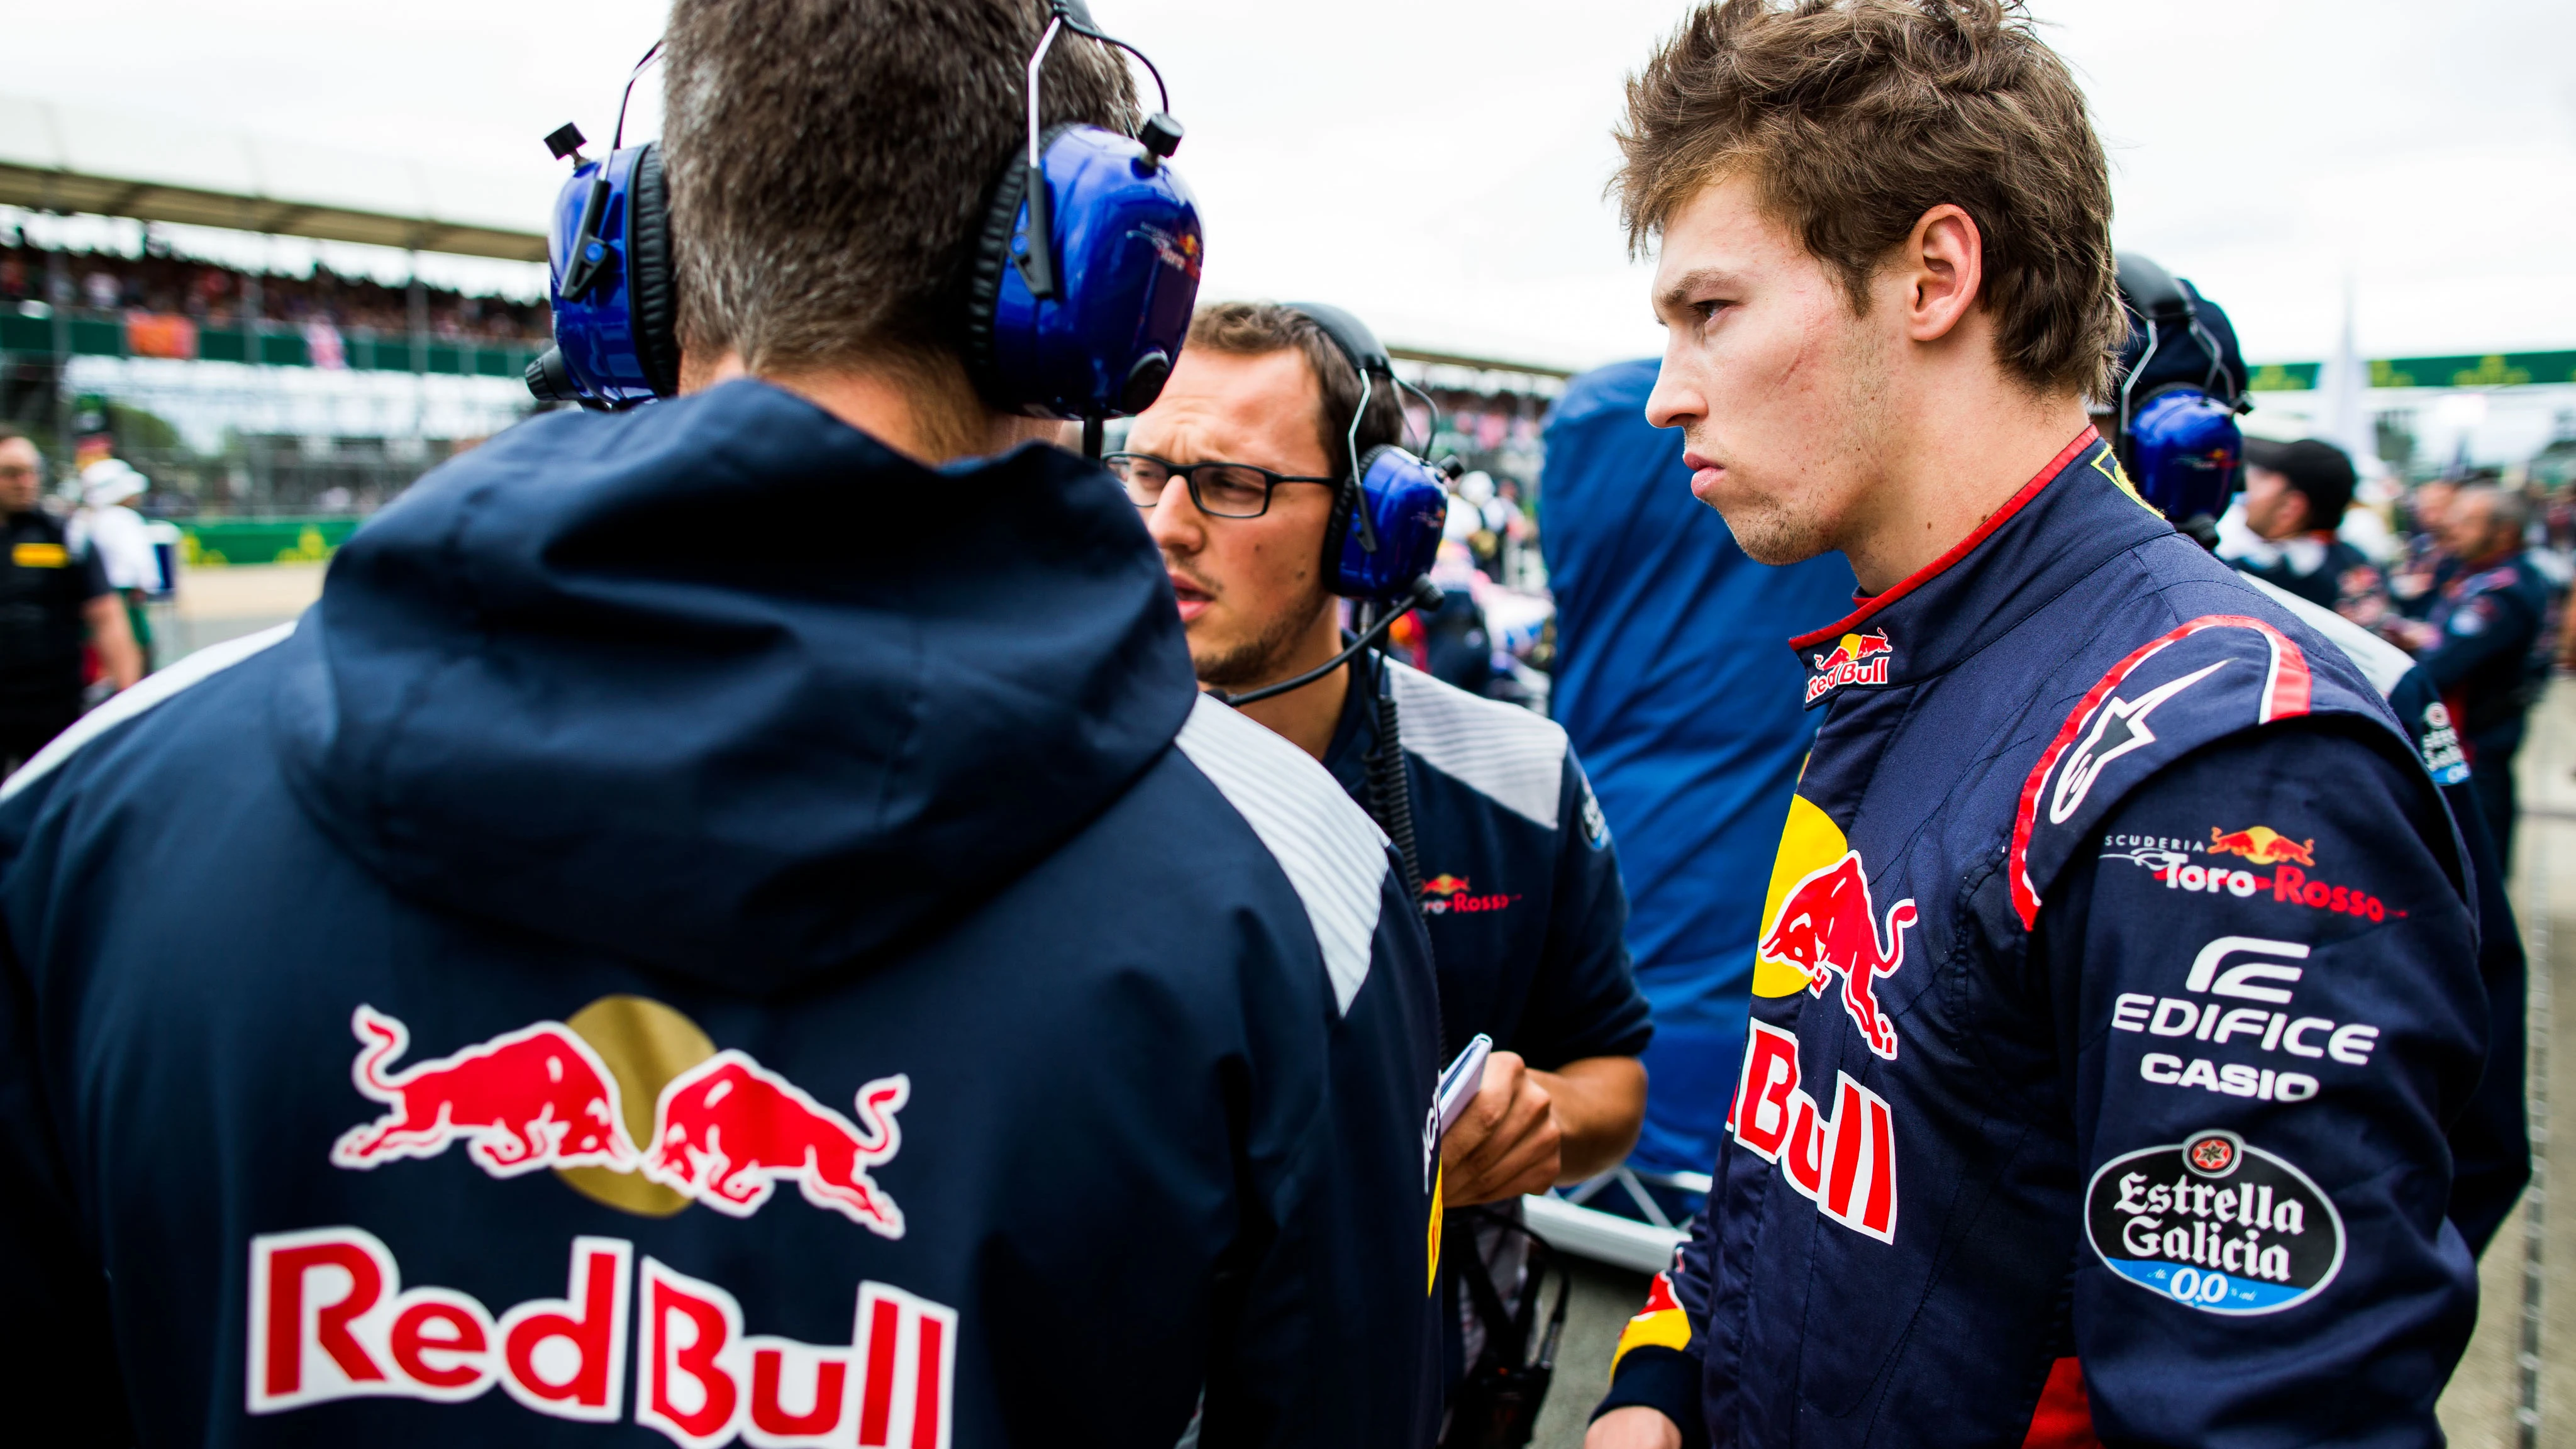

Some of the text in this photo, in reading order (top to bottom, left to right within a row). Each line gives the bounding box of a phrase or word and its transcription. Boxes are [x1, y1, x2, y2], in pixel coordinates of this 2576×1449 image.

[1806, 657, 1890, 703] Red Bull
[2105, 835, 2205, 852] SCUDERIA
[1453, 892, 1509, 913] Rosso
[2160, 852, 2385, 923] Toro Rosso
[2111, 992, 2380, 1065] EDIFICE
[2140, 1052, 2320, 1103] CASIO
[1735, 1018, 1897, 1244] Bull
[2113, 1172, 2305, 1235] Estrella
[2123, 1216, 2291, 1282] Galicia
[250, 1228, 956, 1449] Red Bull
